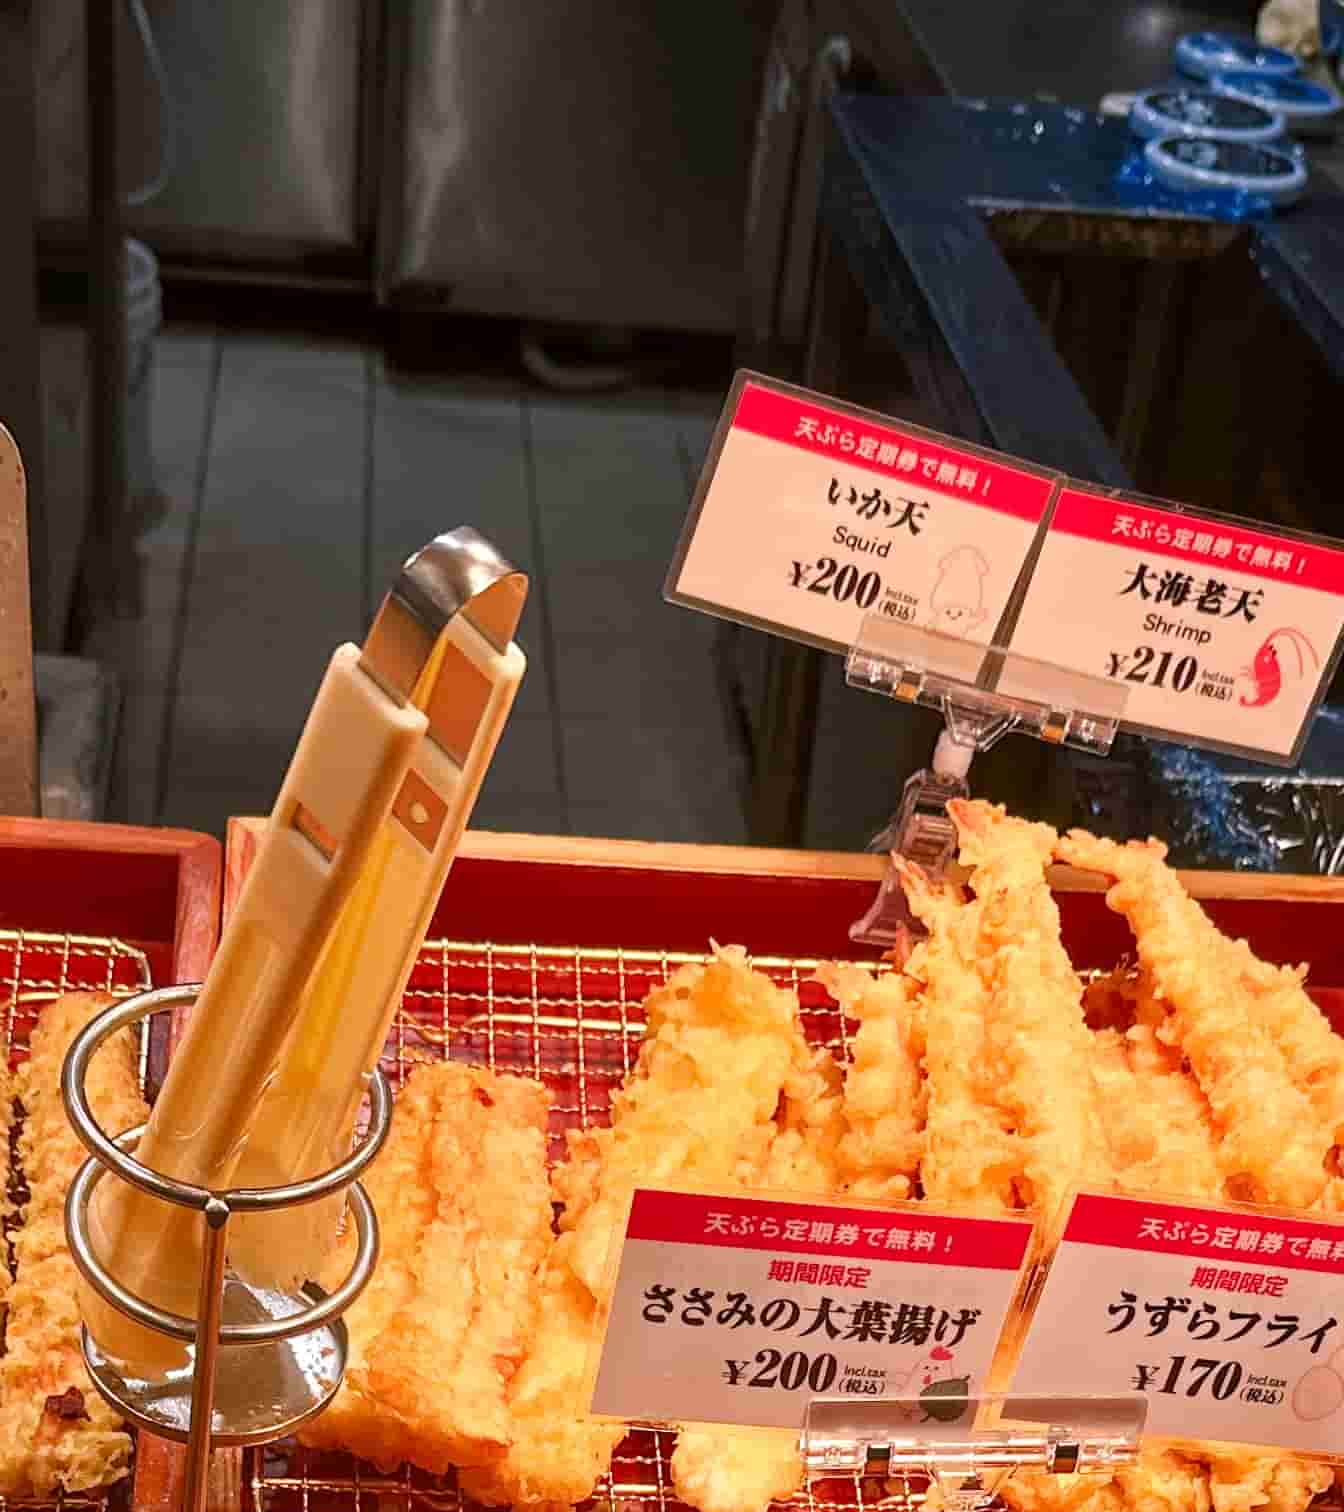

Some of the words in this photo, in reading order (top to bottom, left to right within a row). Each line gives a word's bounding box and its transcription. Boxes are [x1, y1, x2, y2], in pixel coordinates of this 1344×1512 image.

[827, 478, 930, 536] いか天
[833, 526, 892, 558] Squid
[788, 557, 881, 609] ¥200
[1118, 562, 1265, 624] 大海老天
[1143, 613, 1212, 646] Shrimp
[1106, 646, 1198, 693] ¥210
[704, 1211, 953, 1253] 天ぷら定期券で無料!
[767, 1259, 872, 1288] 期間限定
[1190, 1266, 1288, 1297] 期間限定
[642, 1283, 981, 1348] ささみの大葉揚げ
[1105, 1289, 1338, 1354] うずらフライ
[721, 1348, 838, 1393] ¥200
[1128, 1355, 1242, 1401] ¥170
